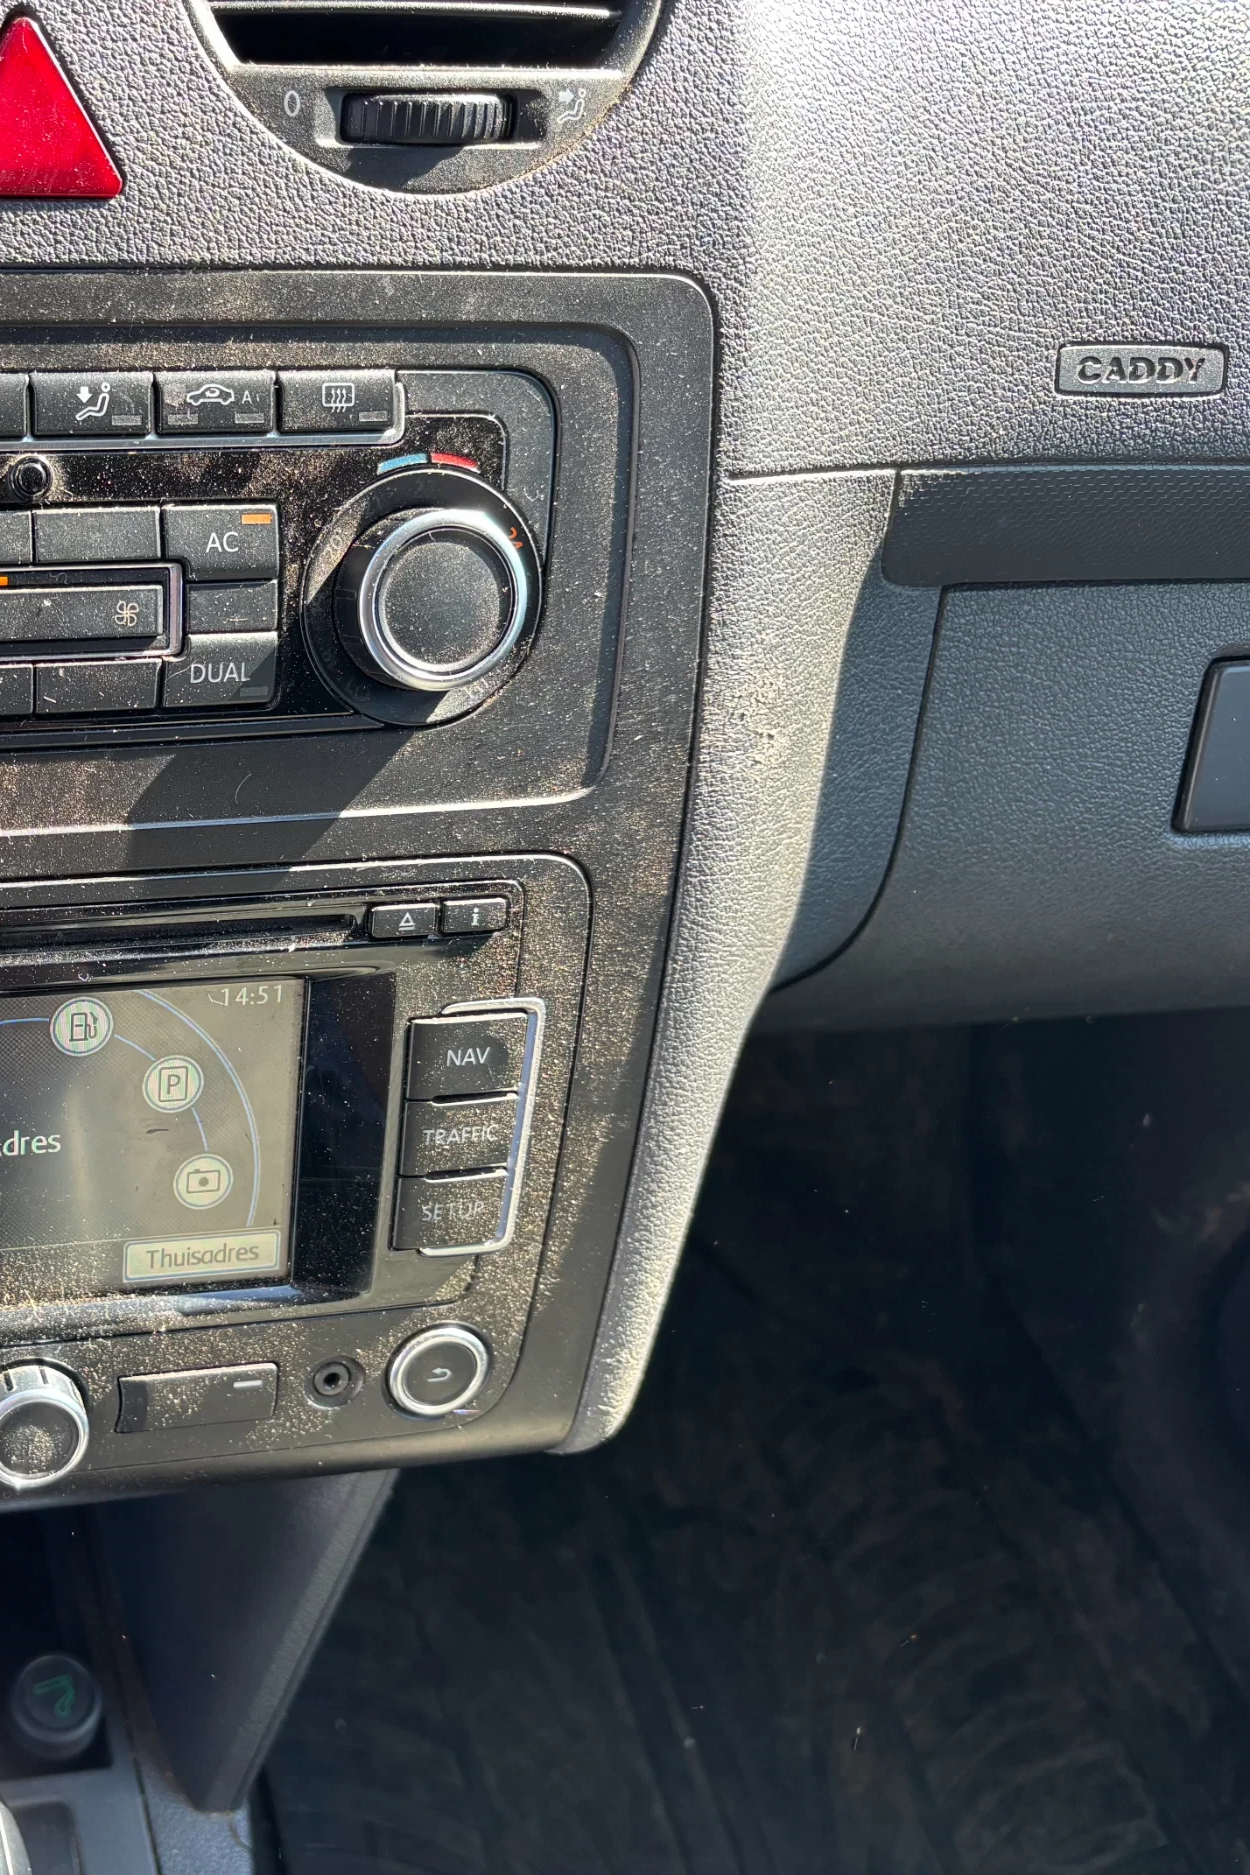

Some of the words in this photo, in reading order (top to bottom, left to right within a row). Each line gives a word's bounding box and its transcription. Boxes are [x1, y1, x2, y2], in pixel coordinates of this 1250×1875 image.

[1076, 355, 1206, 384] CADDY
[205, 531, 240, 554] AC
[190, 661, 252, 684] DUAL
[221, 984, 282, 1006] 14:51
[446, 1046, 491, 1066] NAV
[166, 1073, 181, 1095] P
[422, 1123, 500, 1146] TRAFFIC
[146, 1243, 260, 1270] Thuisadres
